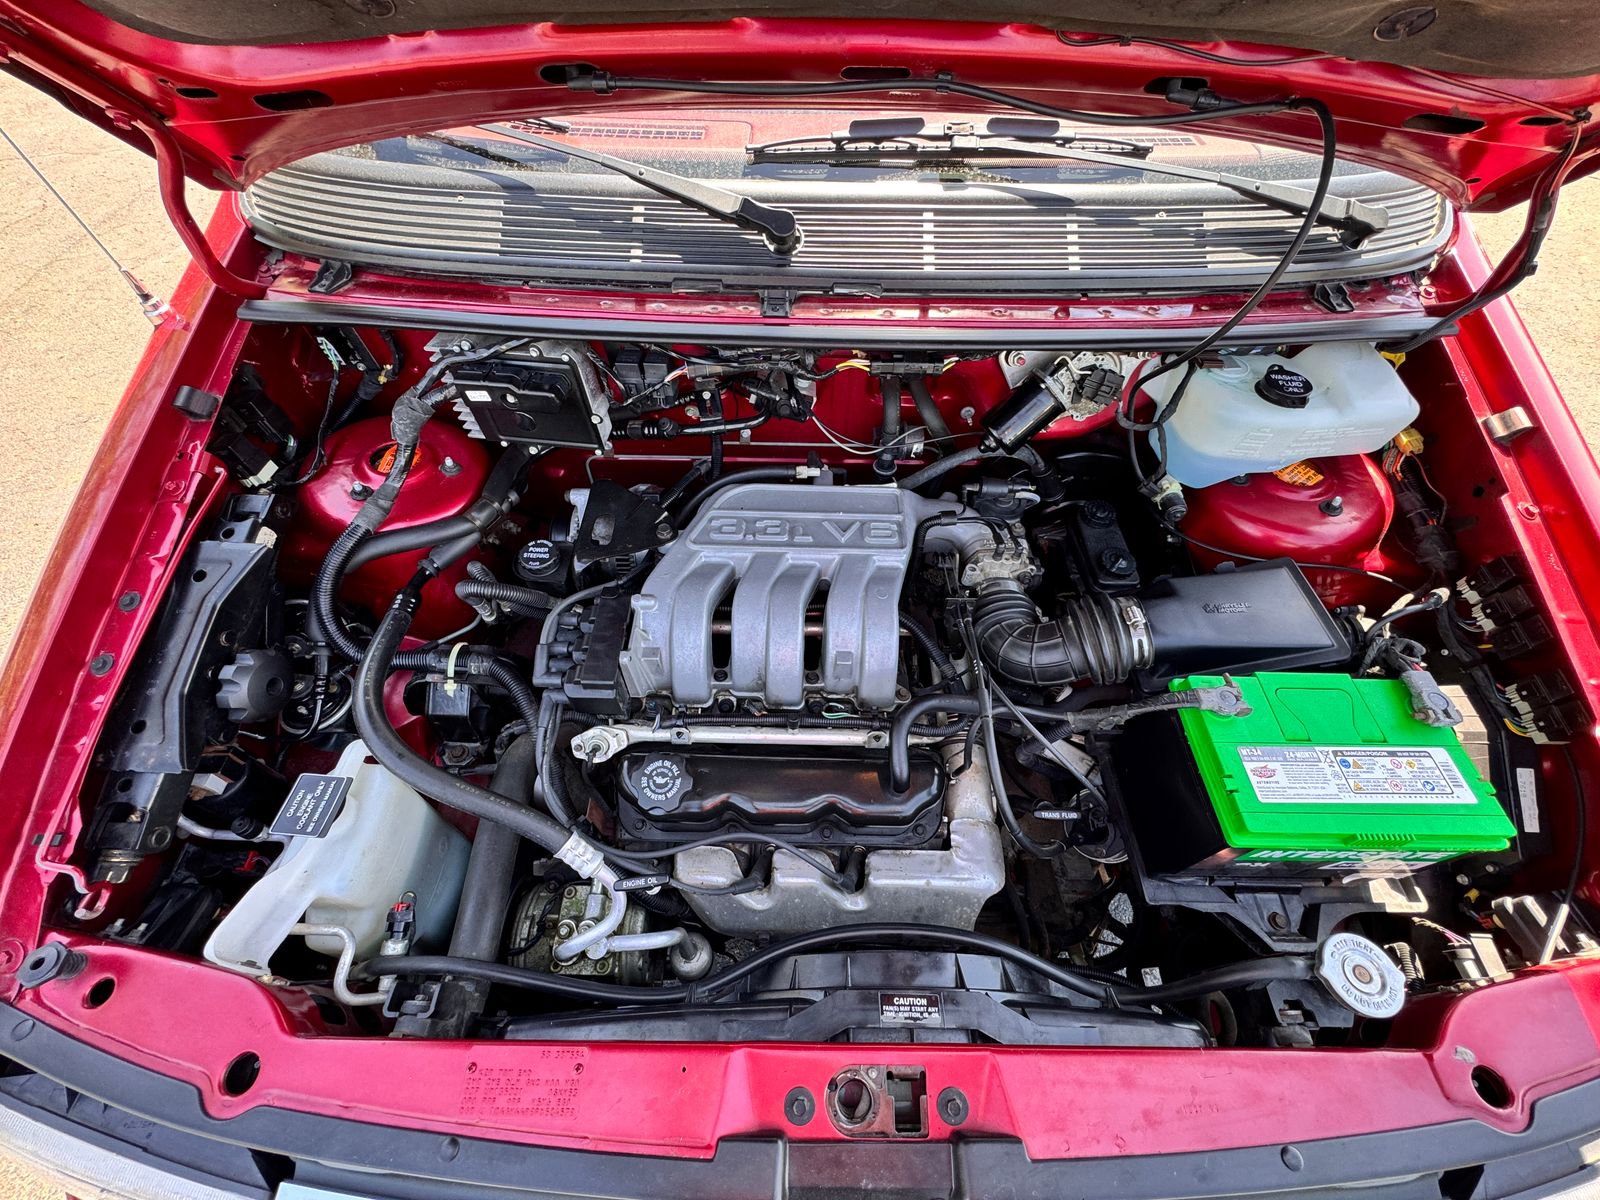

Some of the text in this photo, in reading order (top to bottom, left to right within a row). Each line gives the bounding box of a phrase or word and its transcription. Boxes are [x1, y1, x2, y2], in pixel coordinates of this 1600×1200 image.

[822, 521, 899, 544] V6
[644, 760, 663, 775] ENGINE
[663, 760, 673, 769] OIL
[671, 764, 681, 777] FILL
[643, 788, 667, 801] OWNERS
[665, 777, 682, 799] MANUAL
[286, 790, 306, 816] CAUTION
[296, 792, 314, 817] ENGINE
[296, 780, 326, 830] COOLANT ONLY
[306, 780, 337, 832] SEE OWNERS MANUAL
[1041, 811, 1060, 819] TRANS
[622, 877, 658, 888] ENGINE OIL
[894, 997, 927, 1006] CAUTION
